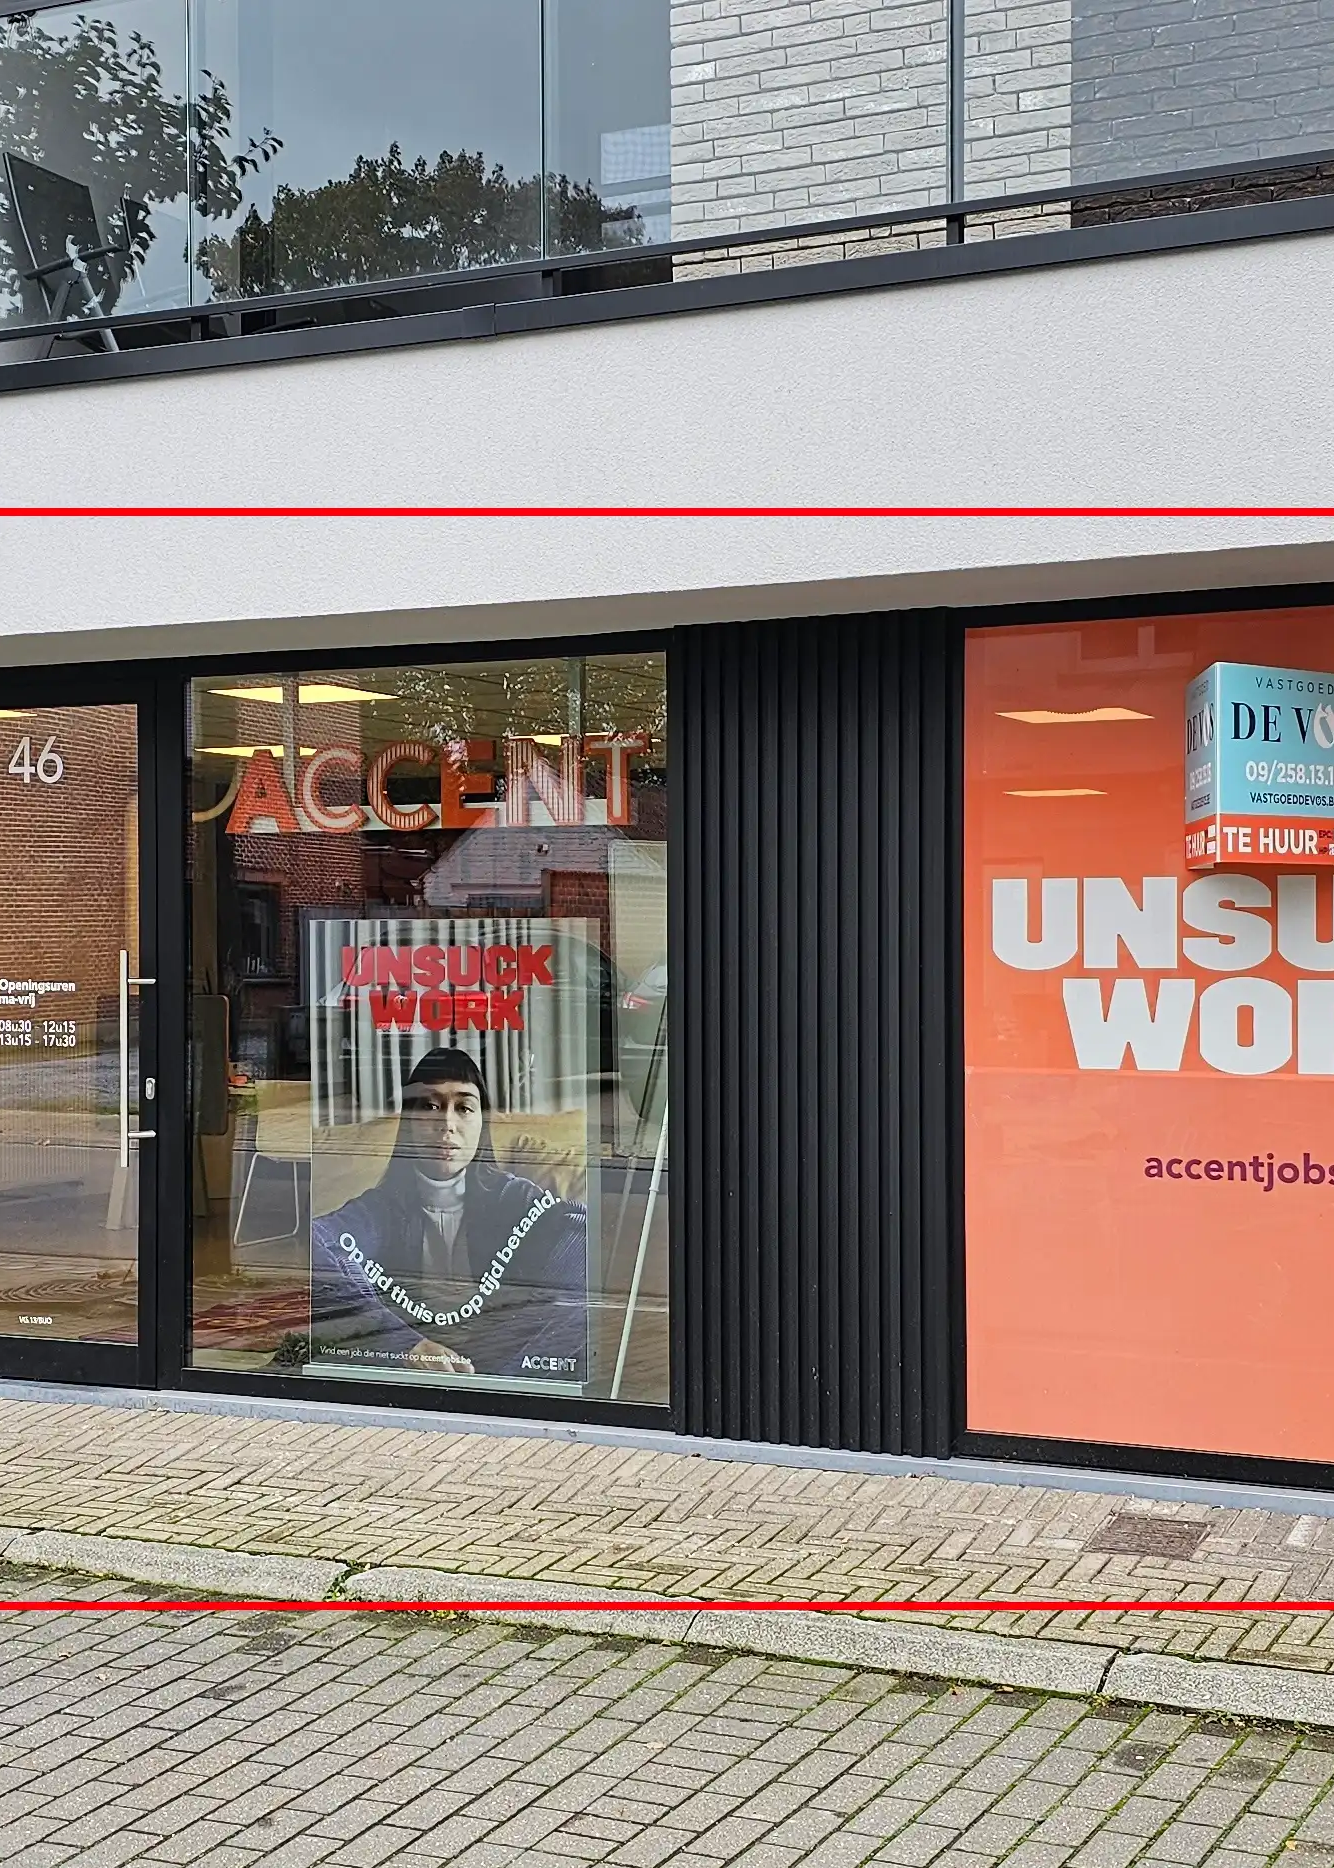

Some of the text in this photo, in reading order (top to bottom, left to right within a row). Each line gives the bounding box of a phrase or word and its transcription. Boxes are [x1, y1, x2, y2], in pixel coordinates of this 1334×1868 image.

[1255, 676, 1334, 695] VASTGOED
[1230, 701, 1282, 743] DE
[8, 735, 64, 784] 46
[225, 732, 650, 835] ACCENT
[1222, 826, 1318, 855] TE HUUR
[341, 943, 556, 988] UNSUCK
[369, 987, 525, 1031] WORK
[42, 1020, 76, 1034] 12u15
[42, 1034, 76, 1048] 17u30
[339, 1188, 562, 1327] Op tijd thuis en op tijd betaald.
[319, 1345, 336, 1355] Vind
[336, 1348, 350, 1357] een
[350, 1346, 363, 1359] job
[375, 1350, 389, 1360] niet
[409, 1353, 420, 1363] op
[420, 1353, 472, 1366] accentjobs.be
[520, 1354, 578, 1373] ACCENT
